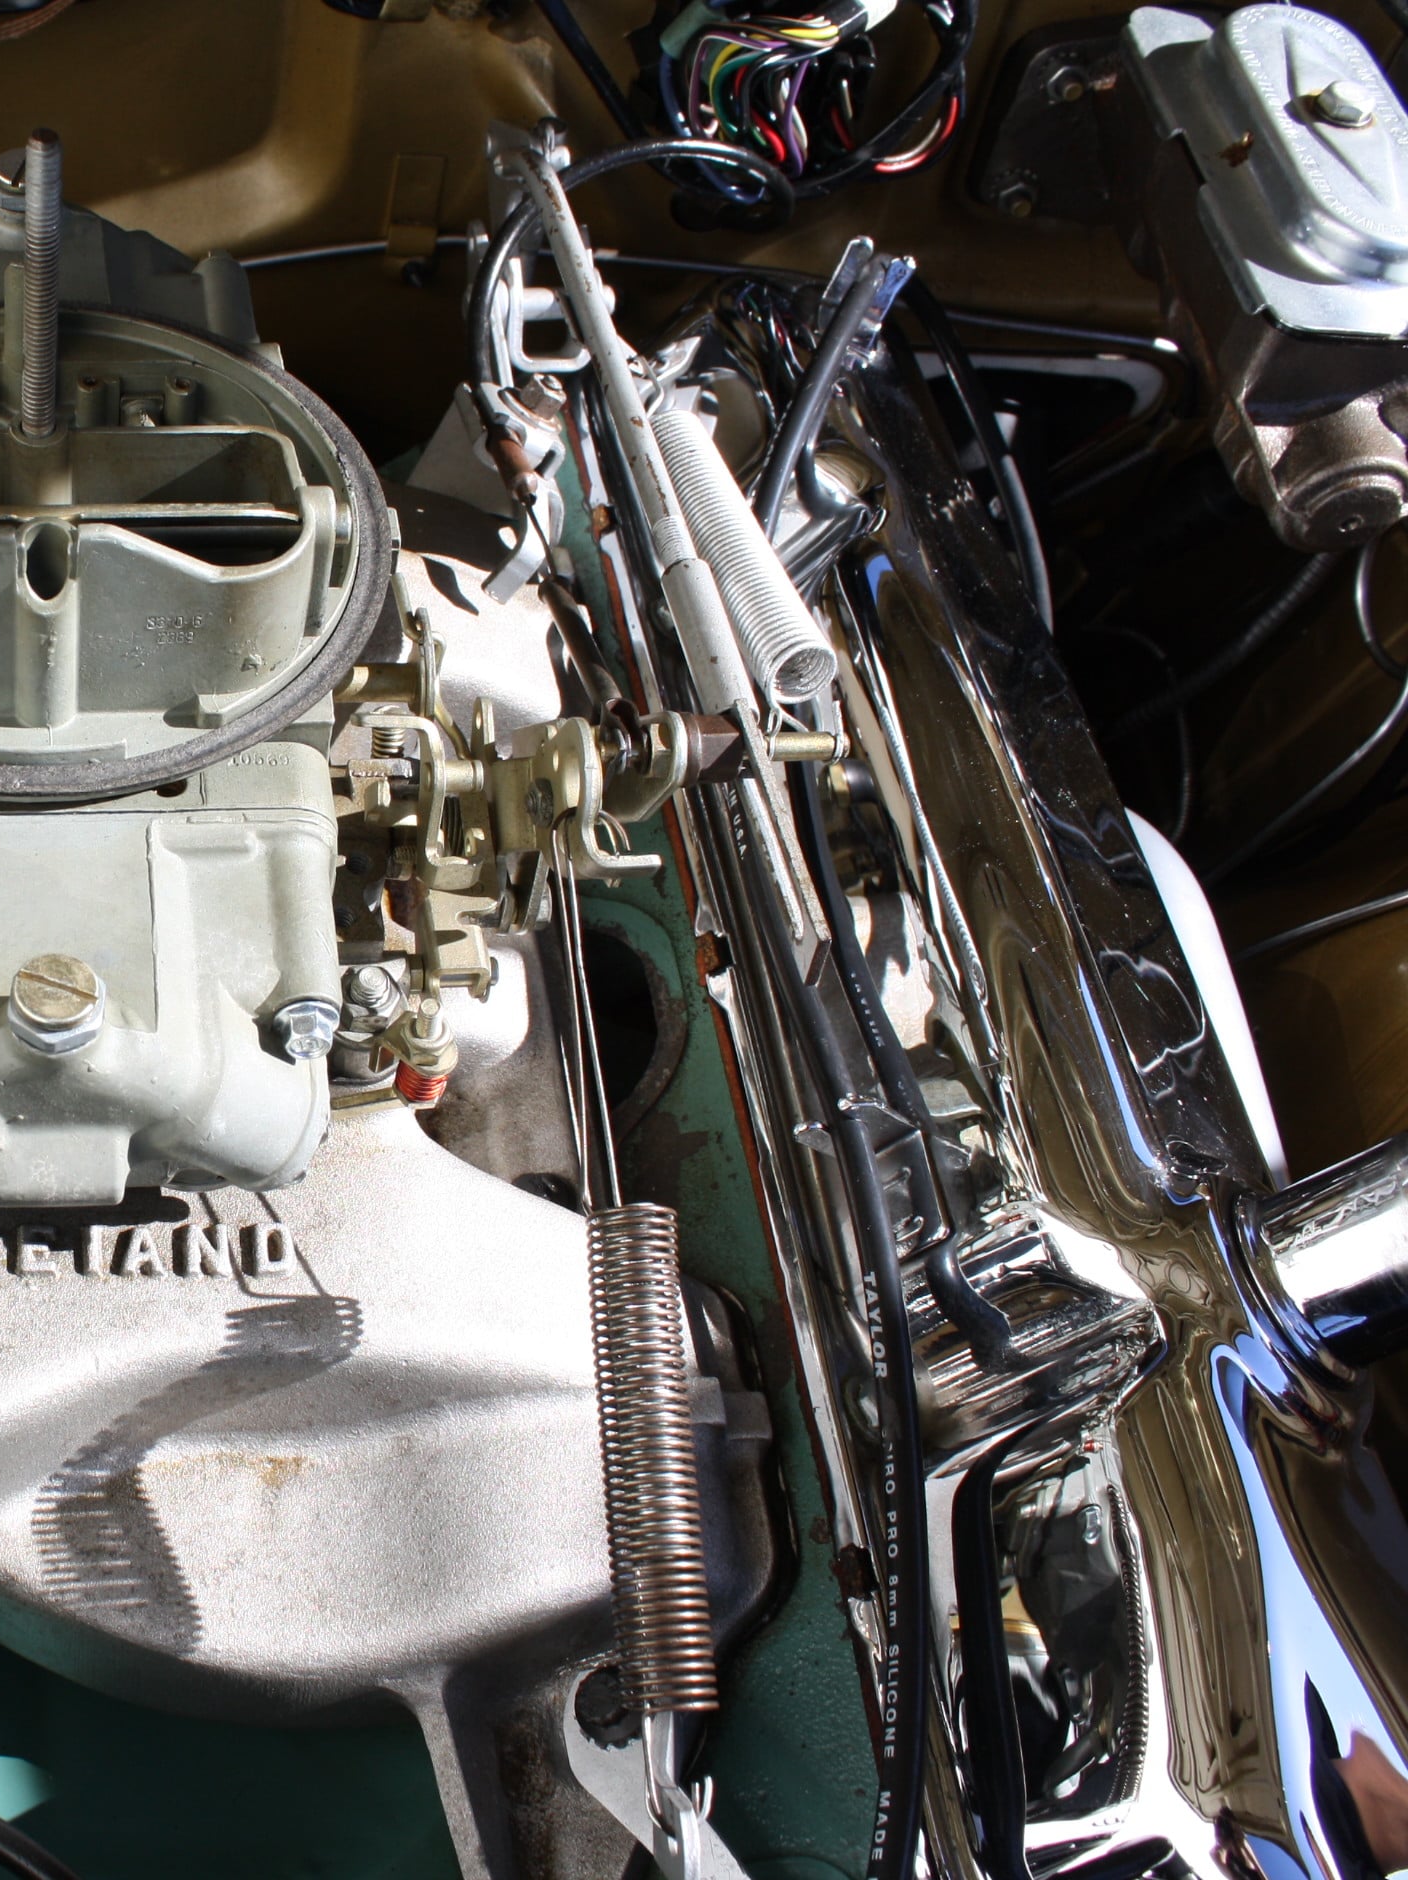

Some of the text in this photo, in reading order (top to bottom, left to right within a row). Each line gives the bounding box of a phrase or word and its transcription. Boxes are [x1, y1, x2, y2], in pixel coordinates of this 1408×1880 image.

[863, 1271, 888, 1379] TAYLOR
[886, 1510, 898, 1558] PRO
[888, 1574, 899, 1627] 8mm
[883, 1644, 900, 1759] SILICONE
[871, 1791, 892, 1861] MADE
